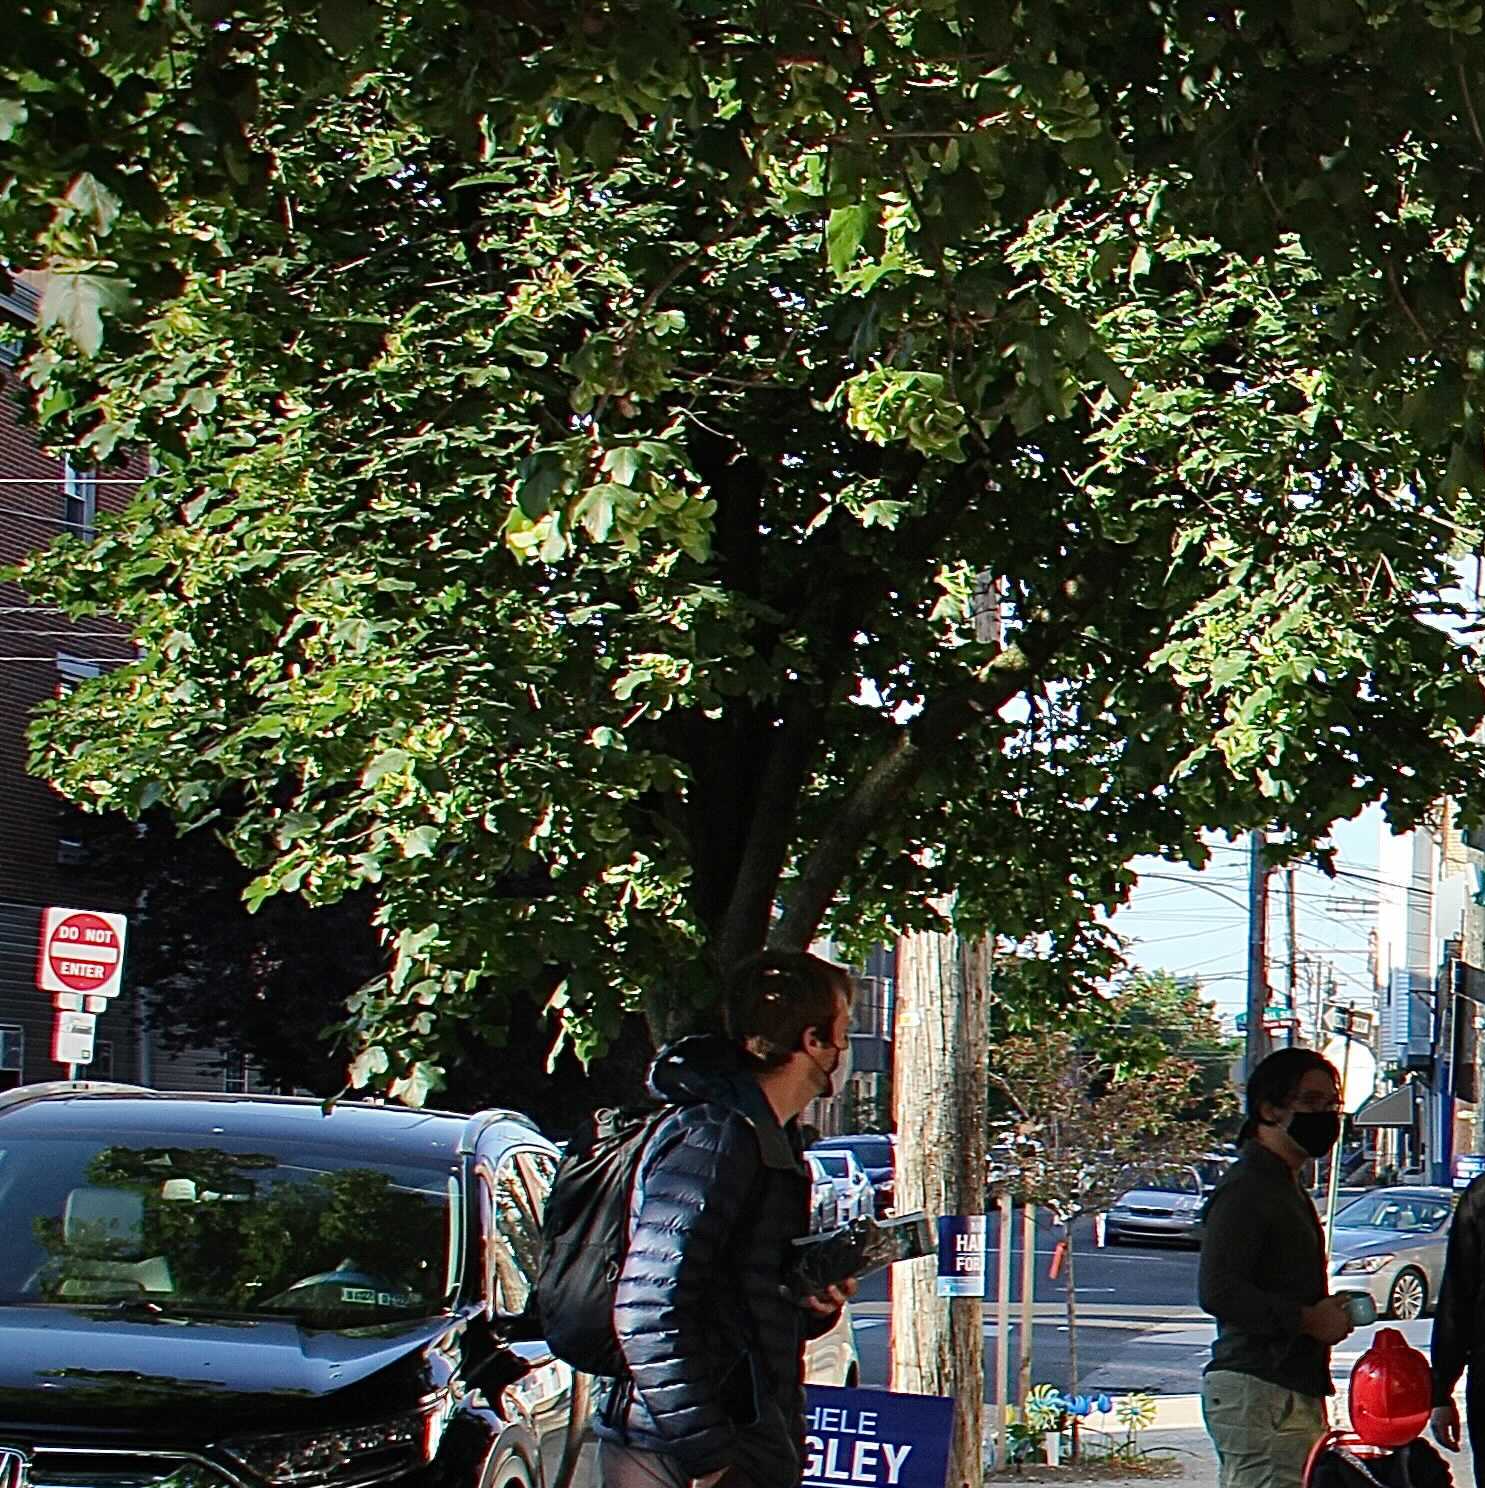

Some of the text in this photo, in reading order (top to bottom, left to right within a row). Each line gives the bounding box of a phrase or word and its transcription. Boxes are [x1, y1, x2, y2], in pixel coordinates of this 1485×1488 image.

[58, 925, 113, 944] DO NOT
[61, 961, 105, 980] ENTER
[801, 1435, 912, 1485] GLEY
